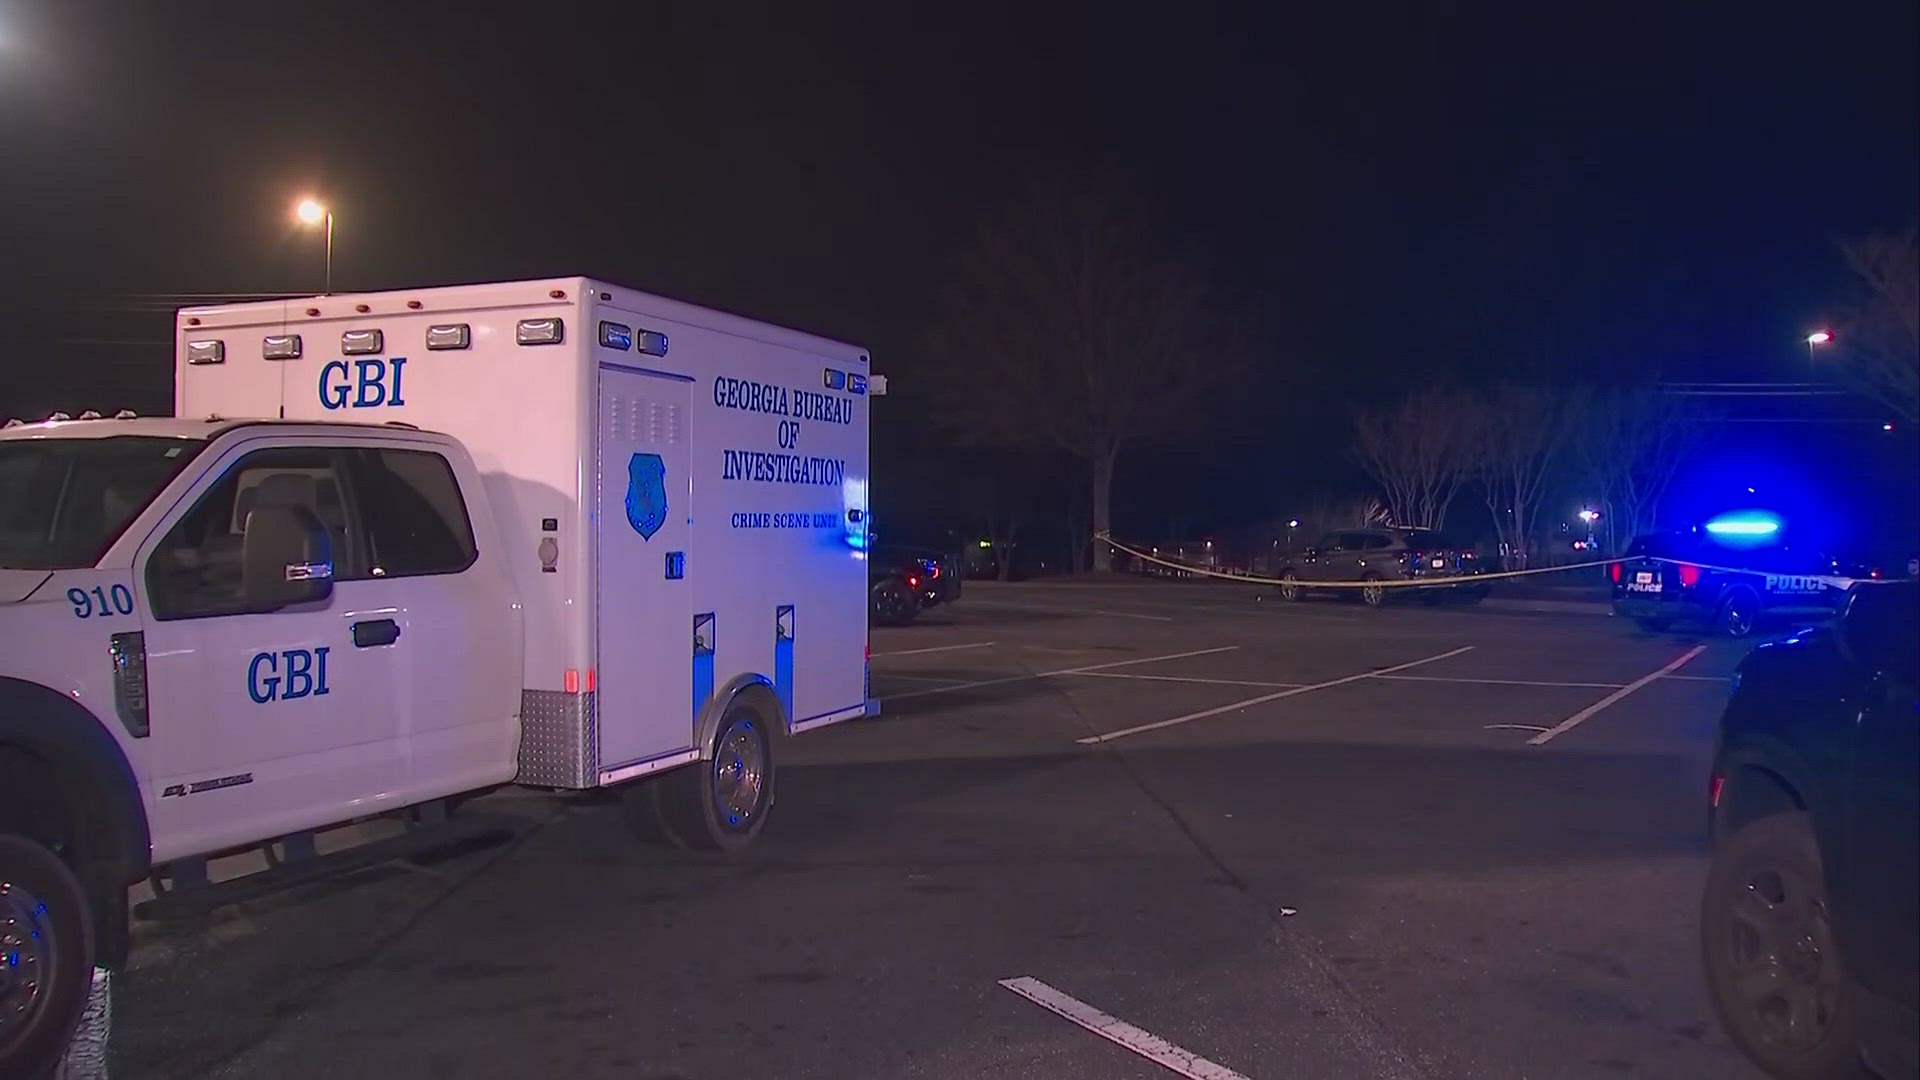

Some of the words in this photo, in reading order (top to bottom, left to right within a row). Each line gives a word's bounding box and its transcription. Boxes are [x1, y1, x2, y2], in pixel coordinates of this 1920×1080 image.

[318, 357, 407, 410] GBI
[713, 376, 788, 416] GEORGIA
[793, 389, 852, 425] BUREAU
[778, 420, 800, 449] OF
[723, 450, 845, 486] INVESTIGATION
[731, 512, 770, 529] CRIME
[773, 513, 810, 529] SCENE
[813, 513, 838, 529] UNIT
[1626, 582, 1663, 593] POLICE
[1765, 575, 1828, 590] POLICE
[66, 583, 134, 619] 910
[248, 647, 330, 704] GBI
